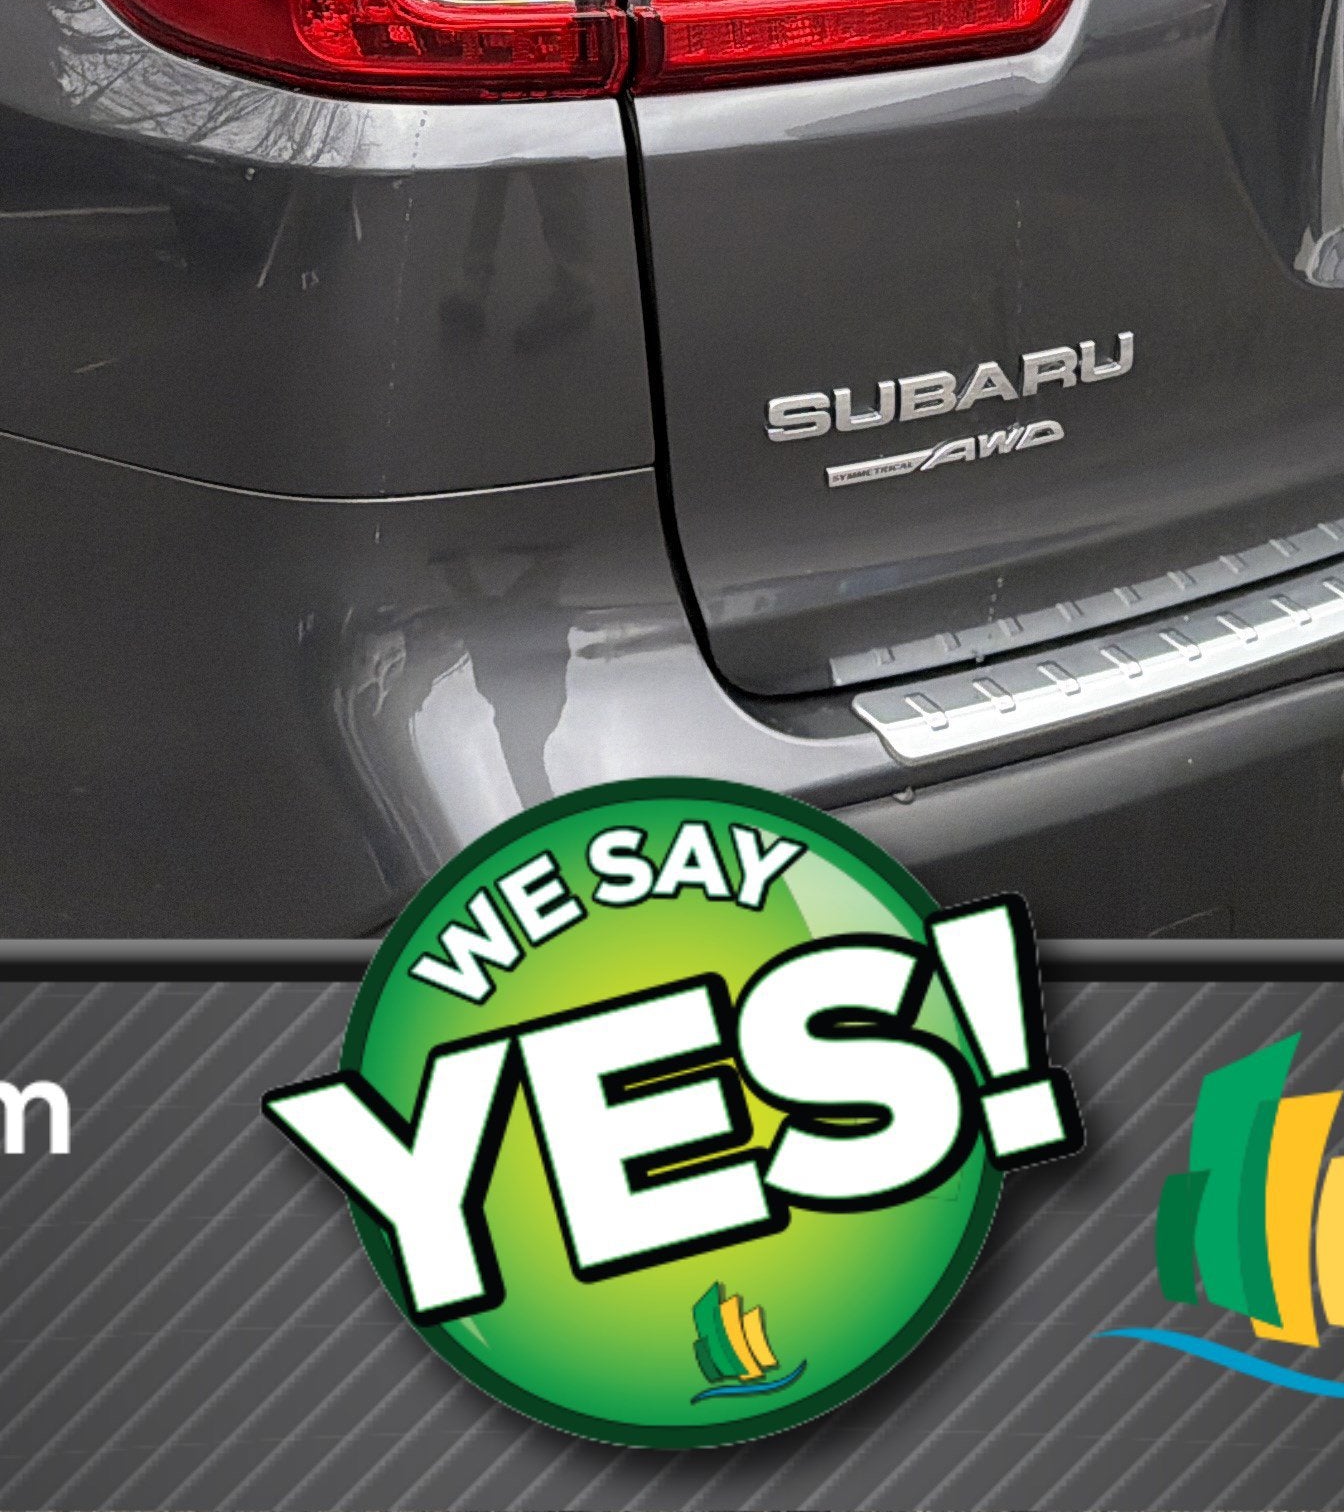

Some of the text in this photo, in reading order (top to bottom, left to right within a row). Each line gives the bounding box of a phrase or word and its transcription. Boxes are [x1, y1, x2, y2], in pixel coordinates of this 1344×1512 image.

[766, 331, 1135, 442] SUBARU
[831, 419, 1065, 483] SYMMETRICAL AWD
